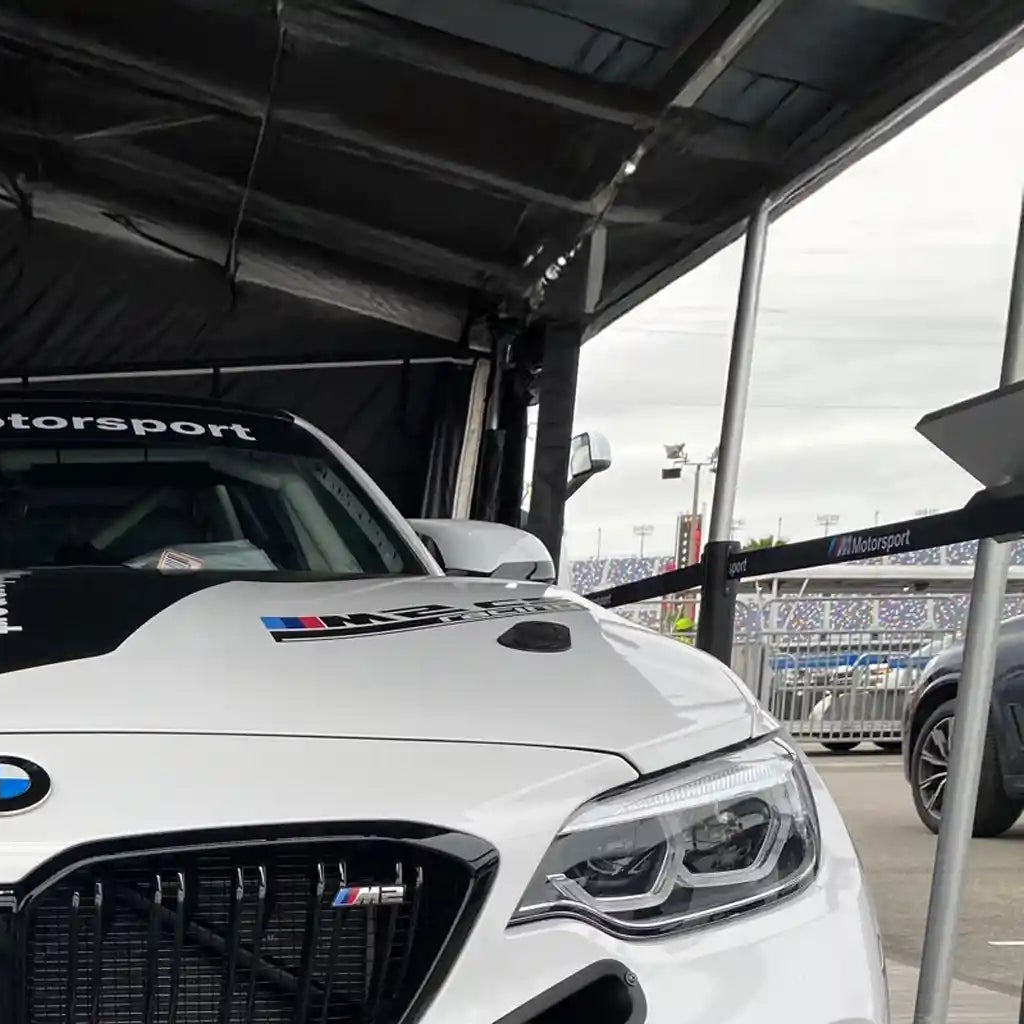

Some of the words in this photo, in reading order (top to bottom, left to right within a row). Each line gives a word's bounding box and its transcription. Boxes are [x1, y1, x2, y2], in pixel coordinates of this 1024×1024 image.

[851, 529, 911, 554] Motorsport
[320, 604, 467, 629] M2
[355, 886, 404, 905] M2
